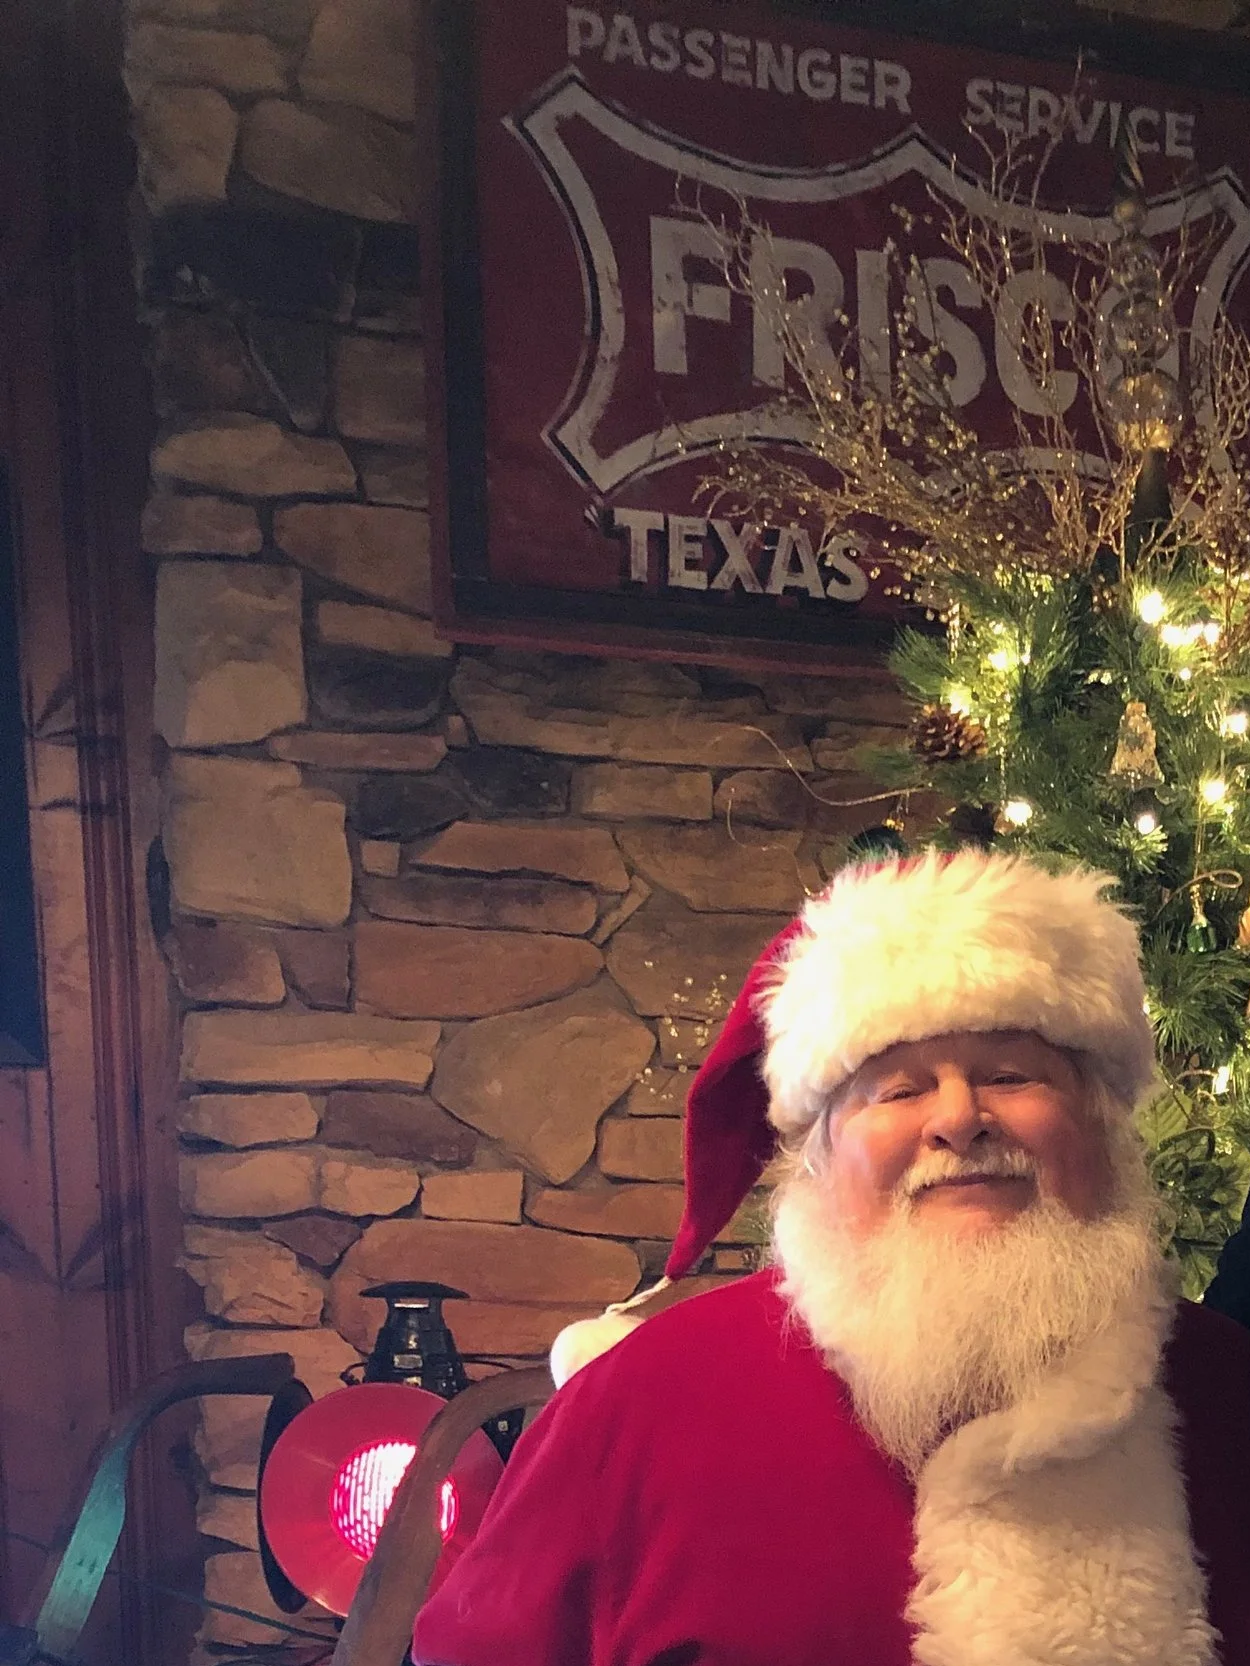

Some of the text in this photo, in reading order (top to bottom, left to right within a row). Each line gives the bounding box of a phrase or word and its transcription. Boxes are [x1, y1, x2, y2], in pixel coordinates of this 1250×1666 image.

[567, 6, 1196, 159] PASSENGER SERVICE
[614, 507, 869, 601] TEXAS
